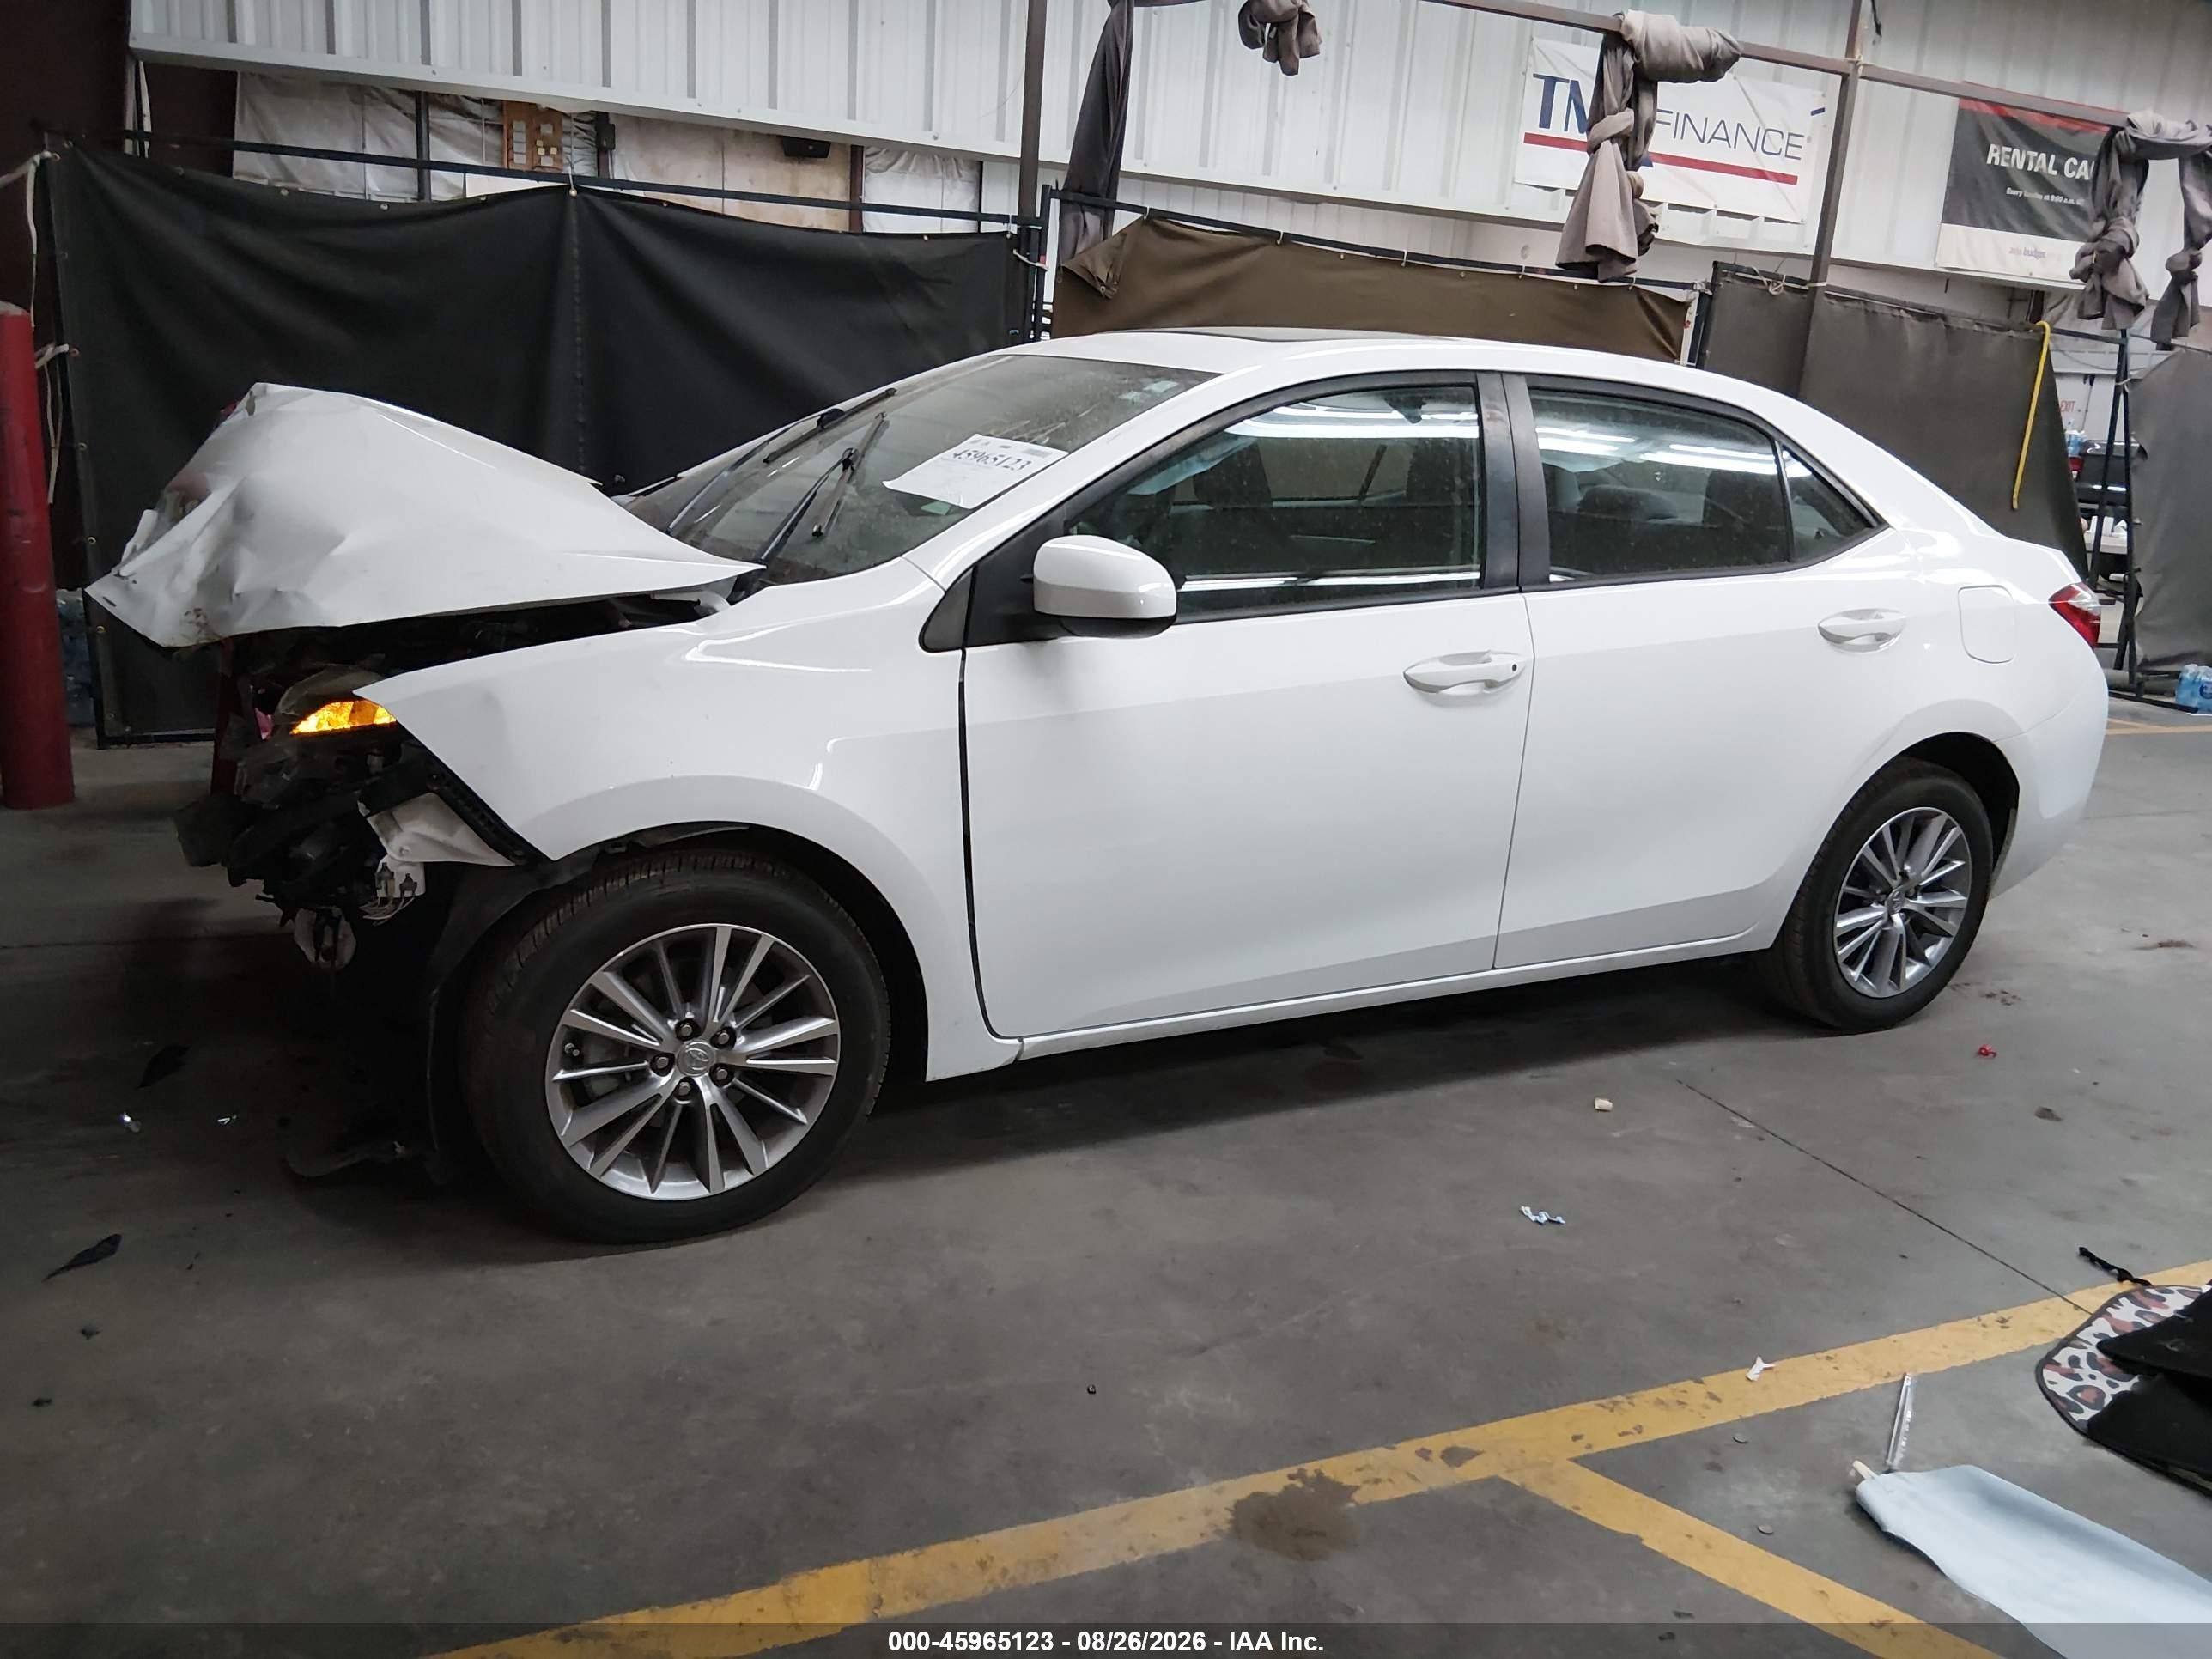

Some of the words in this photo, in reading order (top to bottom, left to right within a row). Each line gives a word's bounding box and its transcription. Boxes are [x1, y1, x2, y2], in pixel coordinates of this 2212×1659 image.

[1656, 108, 1805, 161] FINANCE
[1986, 143, 2057, 176] RENTAL
[2063, 157, 2094, 180] CA
[953, 448, 1032, 471] 45965123
